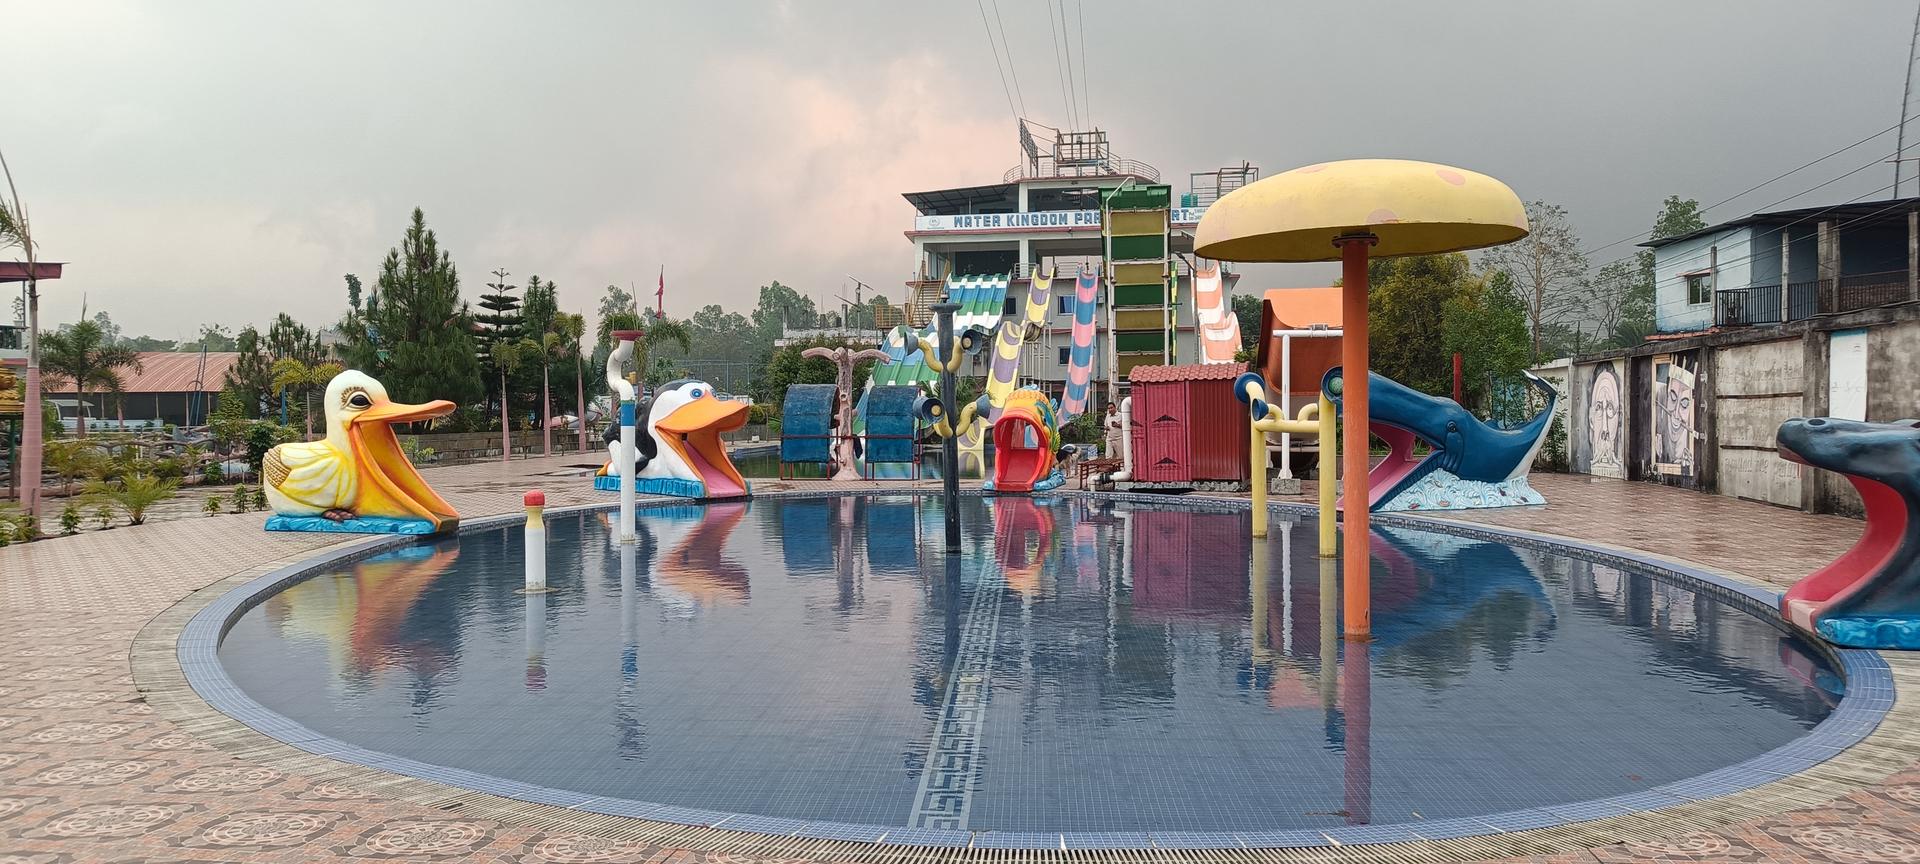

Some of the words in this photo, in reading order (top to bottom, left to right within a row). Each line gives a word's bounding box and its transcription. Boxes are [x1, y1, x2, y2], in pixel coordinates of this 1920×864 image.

[954, 215, 1001, 228] WATER
[1006, 213, 1068, 226] KINGDOM
[1074, 212, 1101, 225] PAR
